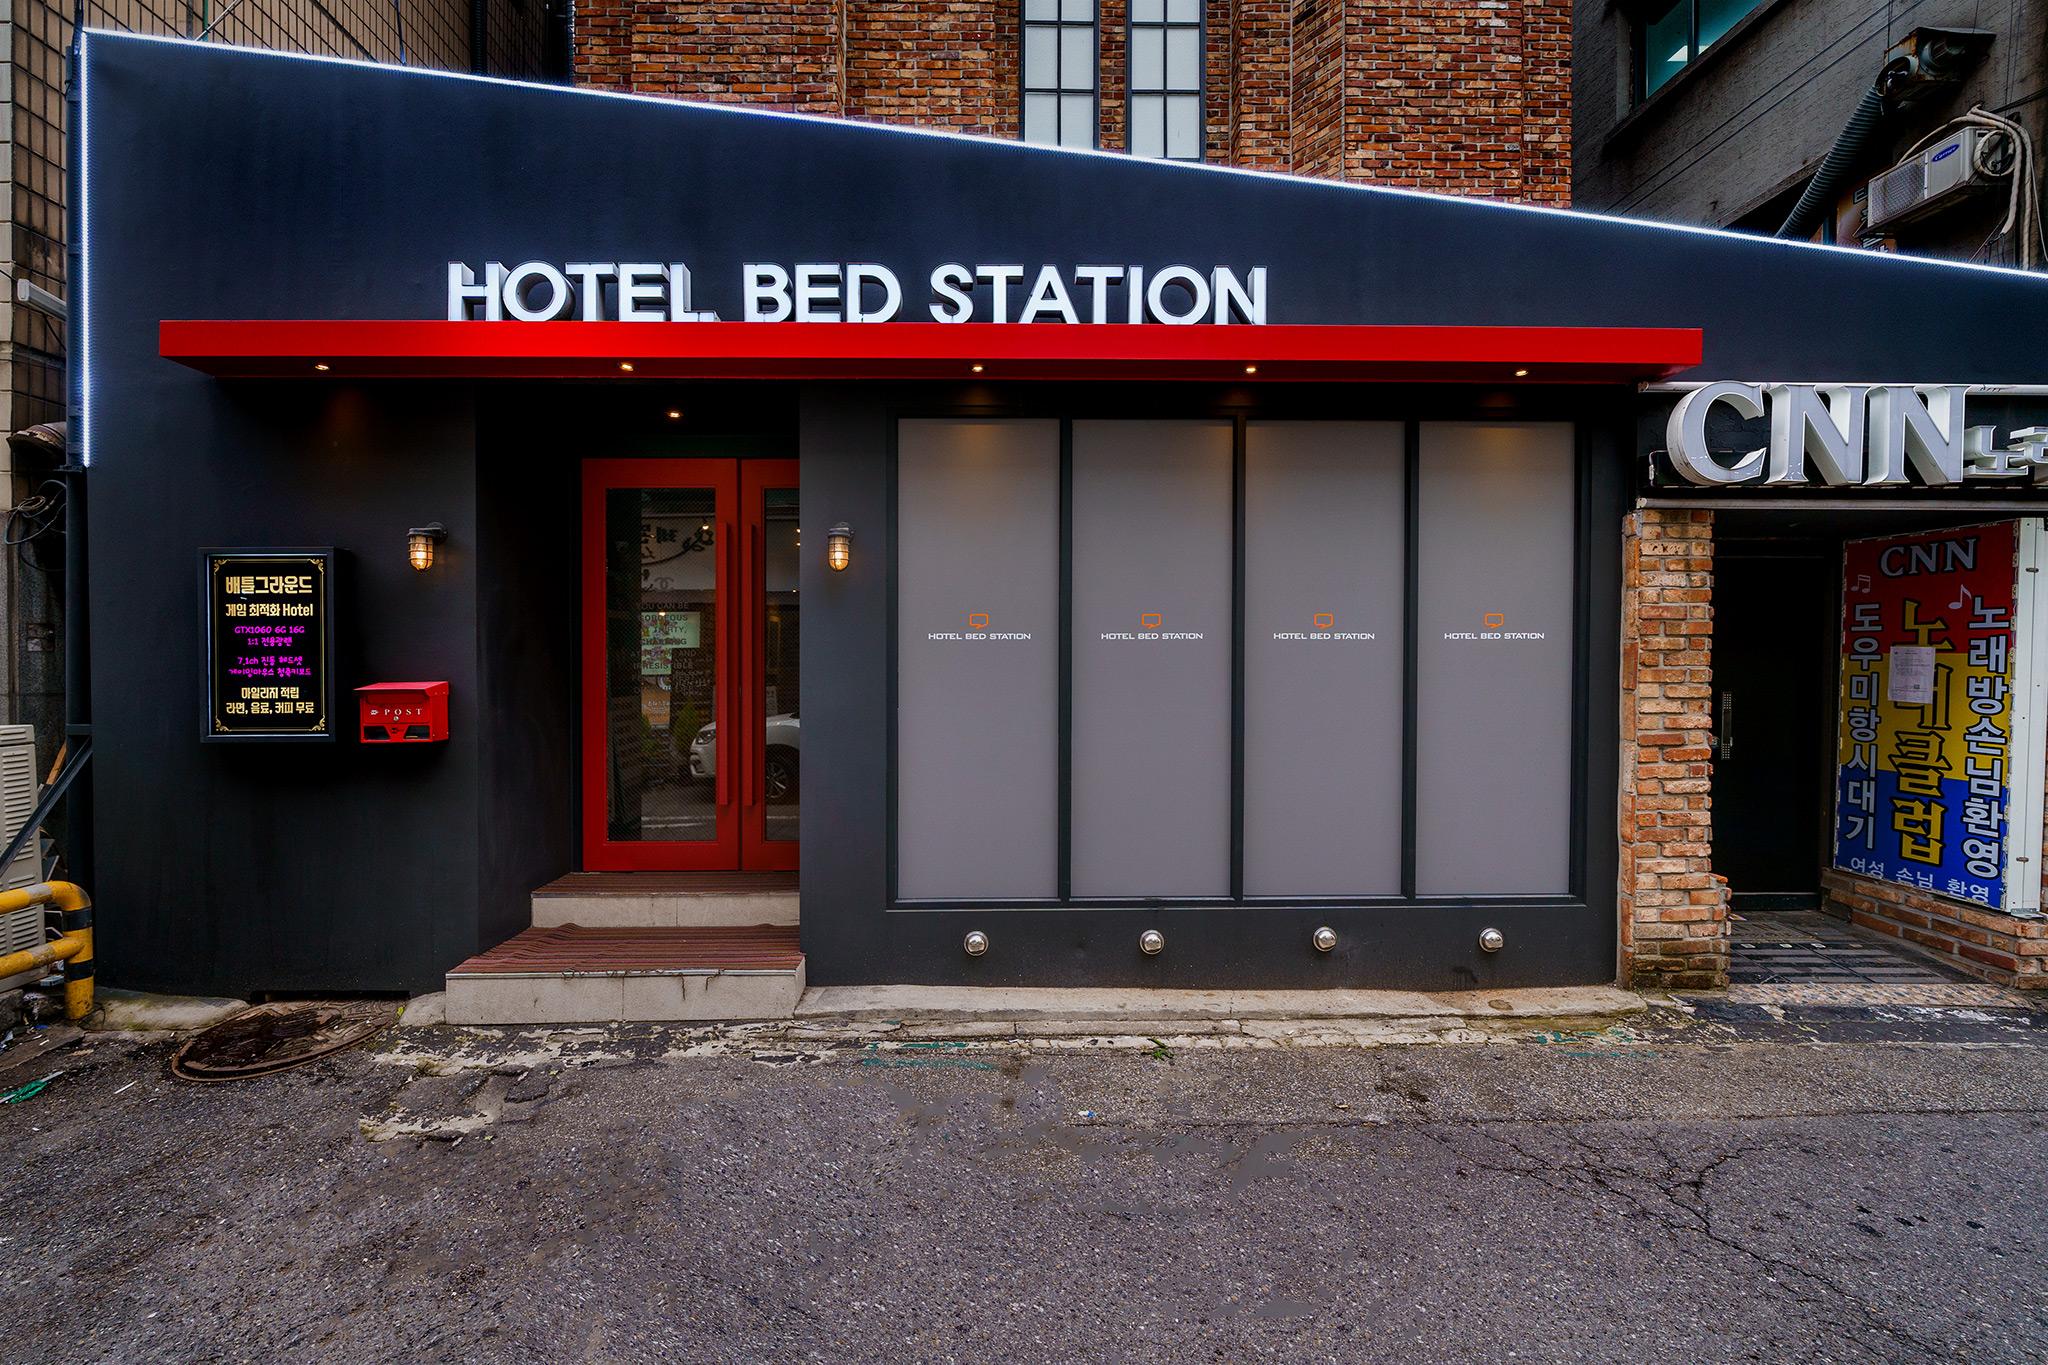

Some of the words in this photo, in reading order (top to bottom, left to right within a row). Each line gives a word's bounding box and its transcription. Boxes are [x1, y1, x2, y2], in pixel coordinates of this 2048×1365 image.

[447, 260, 720, 323] HOTEL
[742, 262, 903, 324] BED
[929, 263, 1268, 326] STATION
[1667, 380, 1972, 486] CNN
[1880, 538, 1977, 577] CNN
[225, 575, 313, 594] 배틀그라운드
[225, 603, 247, 617] 게임
[249, 603, 280, 617] 최적화
[283, 603, 314, 617] Hotel
[234, 625, 272, 634] GTX1060
[275, 625, 287, 634] 6G
[289, 625, 305, 634] 16G
[247, 637, 258, 646] 1:1
[928, 632, 963, 640] HOTEL
[966, 632, 987, 640] BED
[989, 632, 1031, 640] STATION
[1101, 632, 1135, 640] HOTEL
[1138, 632, 1159, 640] BED
[1161, 632, 1203, 640] STATION
[1273, 632, 1308, 640] HOTEL
[1310, 632, 1331, 640] BED
[1334, 632, 1375, 640] STATION
[1444, 632, 1478, 640] HOTEL
[1480, 632, 1501, 640] BED
[1504, 632, 1545, 640] STATION
[261, 656, 276, 666] 진동
[278, 656, 303, 666] 헤드셋
[241, 687, 279, 699] 마일리지
[280, 687, 300, 699] 적립
[225, 702, 249, 715] 라면,
[250, 702, 273, 715] 음료,
[275, 702, 294, 714] 커피
[295, 702, 315, 714] 무료
[384, 708, 423, 716] POST
[1850, 856, 1885, 880] 여성
[1947, 878, 1989, 903] 환영
